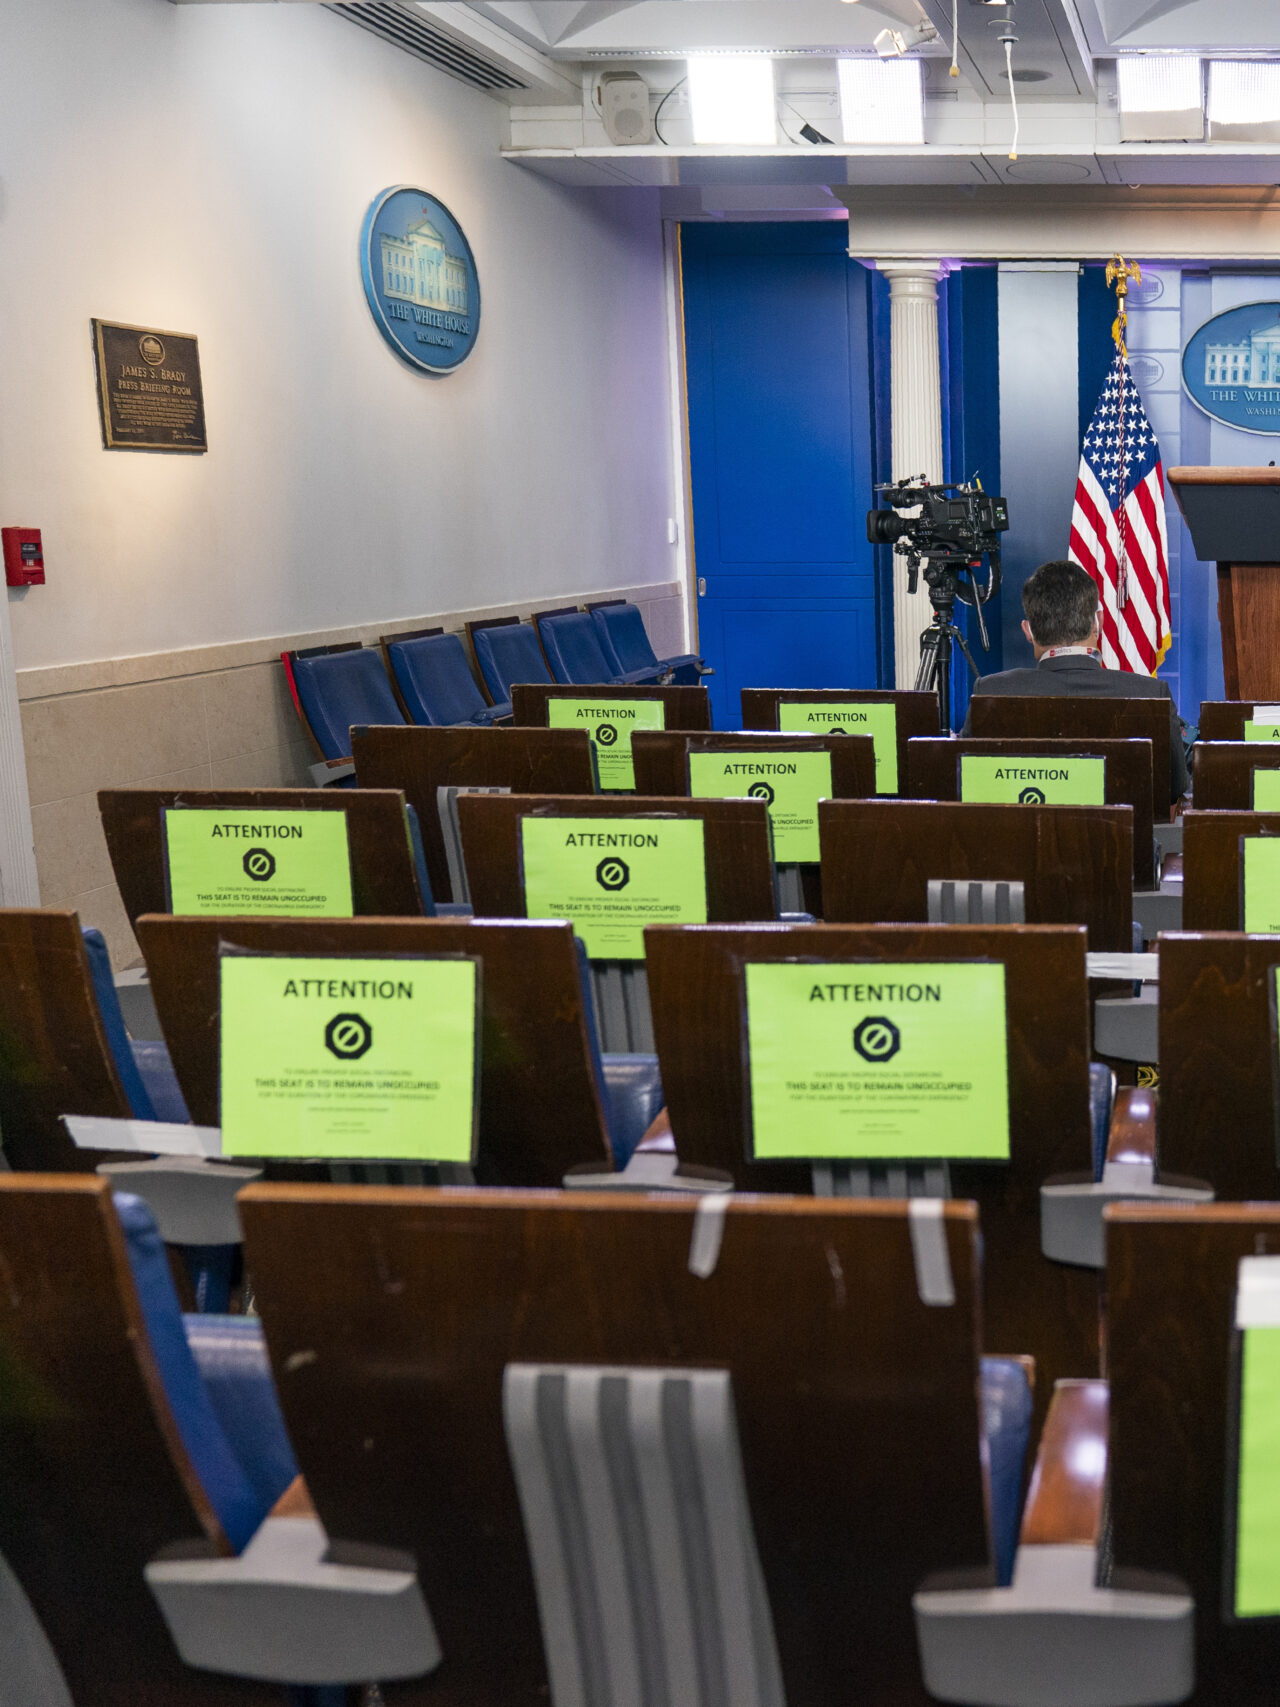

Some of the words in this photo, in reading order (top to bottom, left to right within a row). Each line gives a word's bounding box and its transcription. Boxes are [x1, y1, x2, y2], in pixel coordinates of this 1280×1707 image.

[390, 303, 408, 320] THE
[413, 307, 442, 327] WHITE
[445, 315, 470, 334] HOUSE
[417, 331, 454, 348] WASHINGTON
[122, 365, 147, 378] JAMES
[150, 368, 158, 379] S.
[161, 369, 186, 382] BRADY
[118, 380, 138, 391] PRESS
[140, 381, 171, 393] BRIEFING
[173, 385, 192, 396] ROOM
[1210, 390, 1238, 401] THE
[577, 709, 635, 718] ATTENTION
[808, 713, 867, 721] ATTENTION
[724, 764, 796, 774] ATTENTION
[995, 769, 1068, 780] ATTENTION
[212, 825, 302, 838] ATTENTION
[566, 833, 658, 847] ATTENTION
[252, 894, 279, 902] REMAIN
[280, 894, 327, 902] UNOCCUPIED
[634, 904, 681, 912] UNOCCUPIED
[284, 980, 412, 999] ATTENTION
[809, 984, 940, 1002] ATTENTION
[786, 1081, 807, 1090] THIS
[810, 1081, 832, 1090] SEAT
[836, 1081, 845, 1090] IS
[847, 1081, 861, 1090] TO
[864, 1081, 904, 1090] REMAIN
[906, 1081, 972, 1090] UNOCCUPIED
